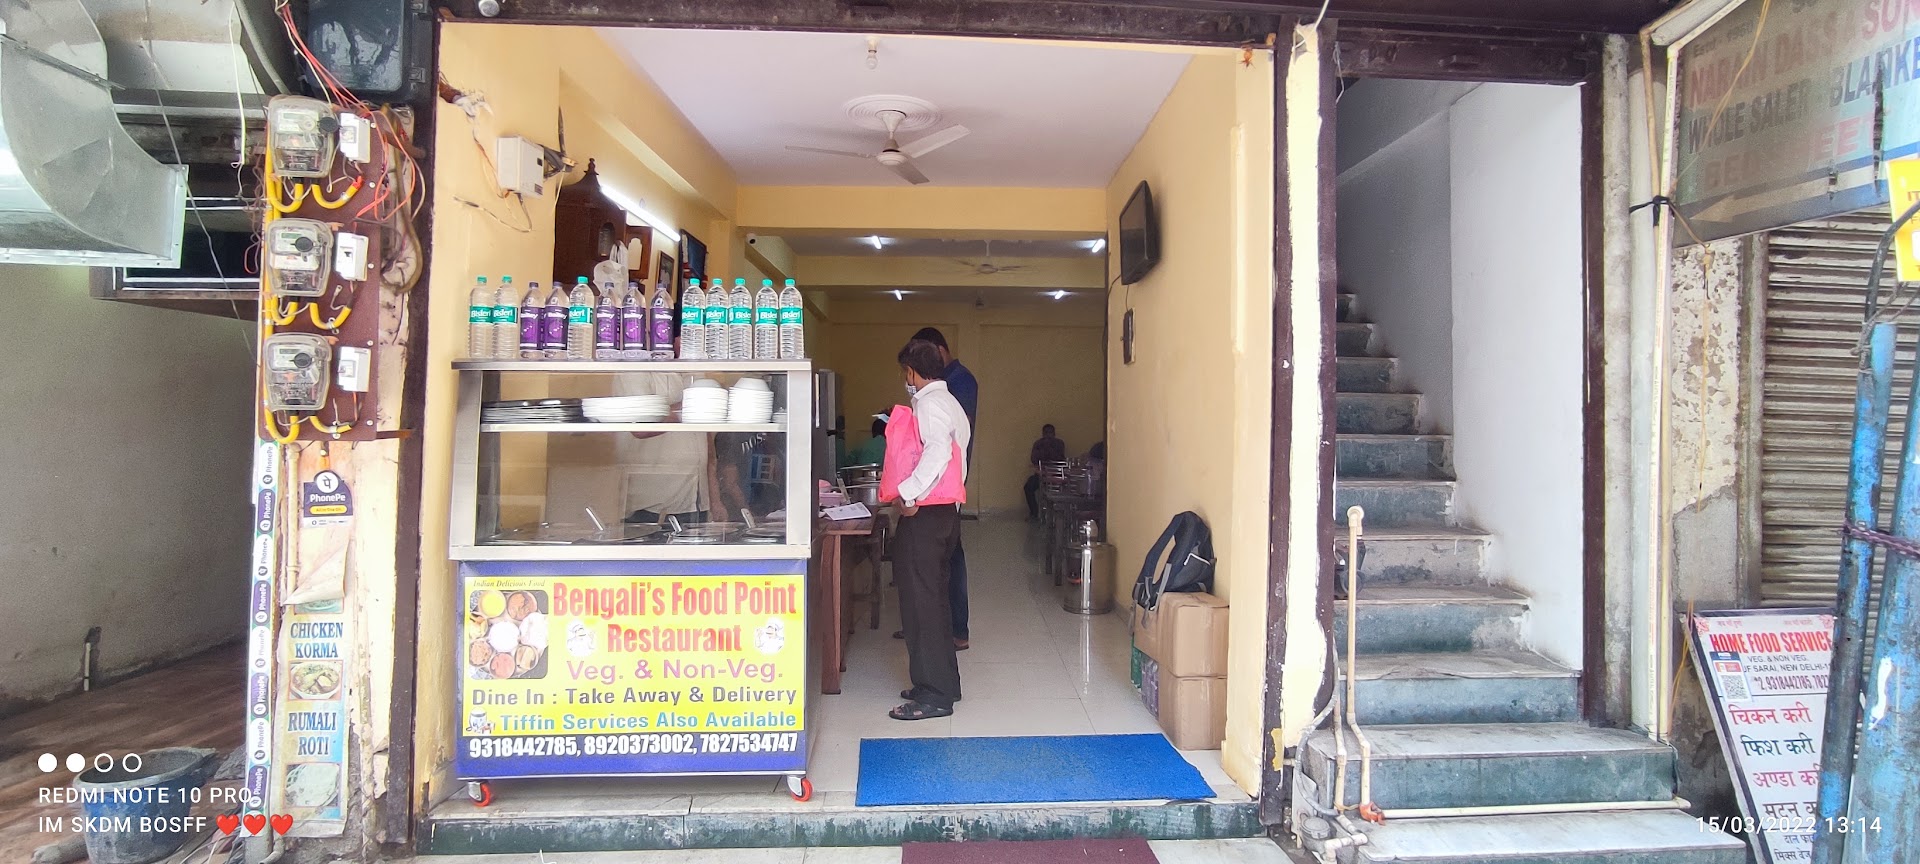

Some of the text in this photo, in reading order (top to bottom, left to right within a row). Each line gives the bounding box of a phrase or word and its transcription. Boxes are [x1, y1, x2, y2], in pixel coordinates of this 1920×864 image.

[263, 491, 272, 519] PhonePe
[310, 493, 346, 503] PhonePe
[259, 583, 267, 611] PhonePe
[672, 581, 728, 615] Food
[734, 581, 797, 615] Point
[290, 622, 343, 638] CHICKEN
[607, 624, 742, 652] Restaurant
[295, 642, 339, 658] KORMA
[1709, 631, 1833, 653] HOME FOOD SERVICE
[1748, 655, 1765, 663] VEG.
[1781, 664, 1798, 672] NEW
[567, 658, 783, 685] Veg. & Non-Veg.
[259, 675, 267, 704] PhonePe
[472, 689, 518, 705] Dine
[526, 688, 544, 705] In
[565, 688, 615, 704] Take
[623, 687, 681, 705] Away
[689, 686, 704, 702] &
[713, 686, 796, 705] Delivery
[288, 712, 337, 731] RUMALI
[500, 711, 796, 731] Tiffin Services Also Available
[1728, 701, 1813, 725] चिकन करी
[298, 736, 329, 755] ROTI
[469, 732, 797, 758] 9318442785, 8920373002, 7827534747
[1740, 732, 1816, 756] फिश करी
[1752, 771, 1796, 788] अण्डा
[1762, 802, 1801, 819] मटन
